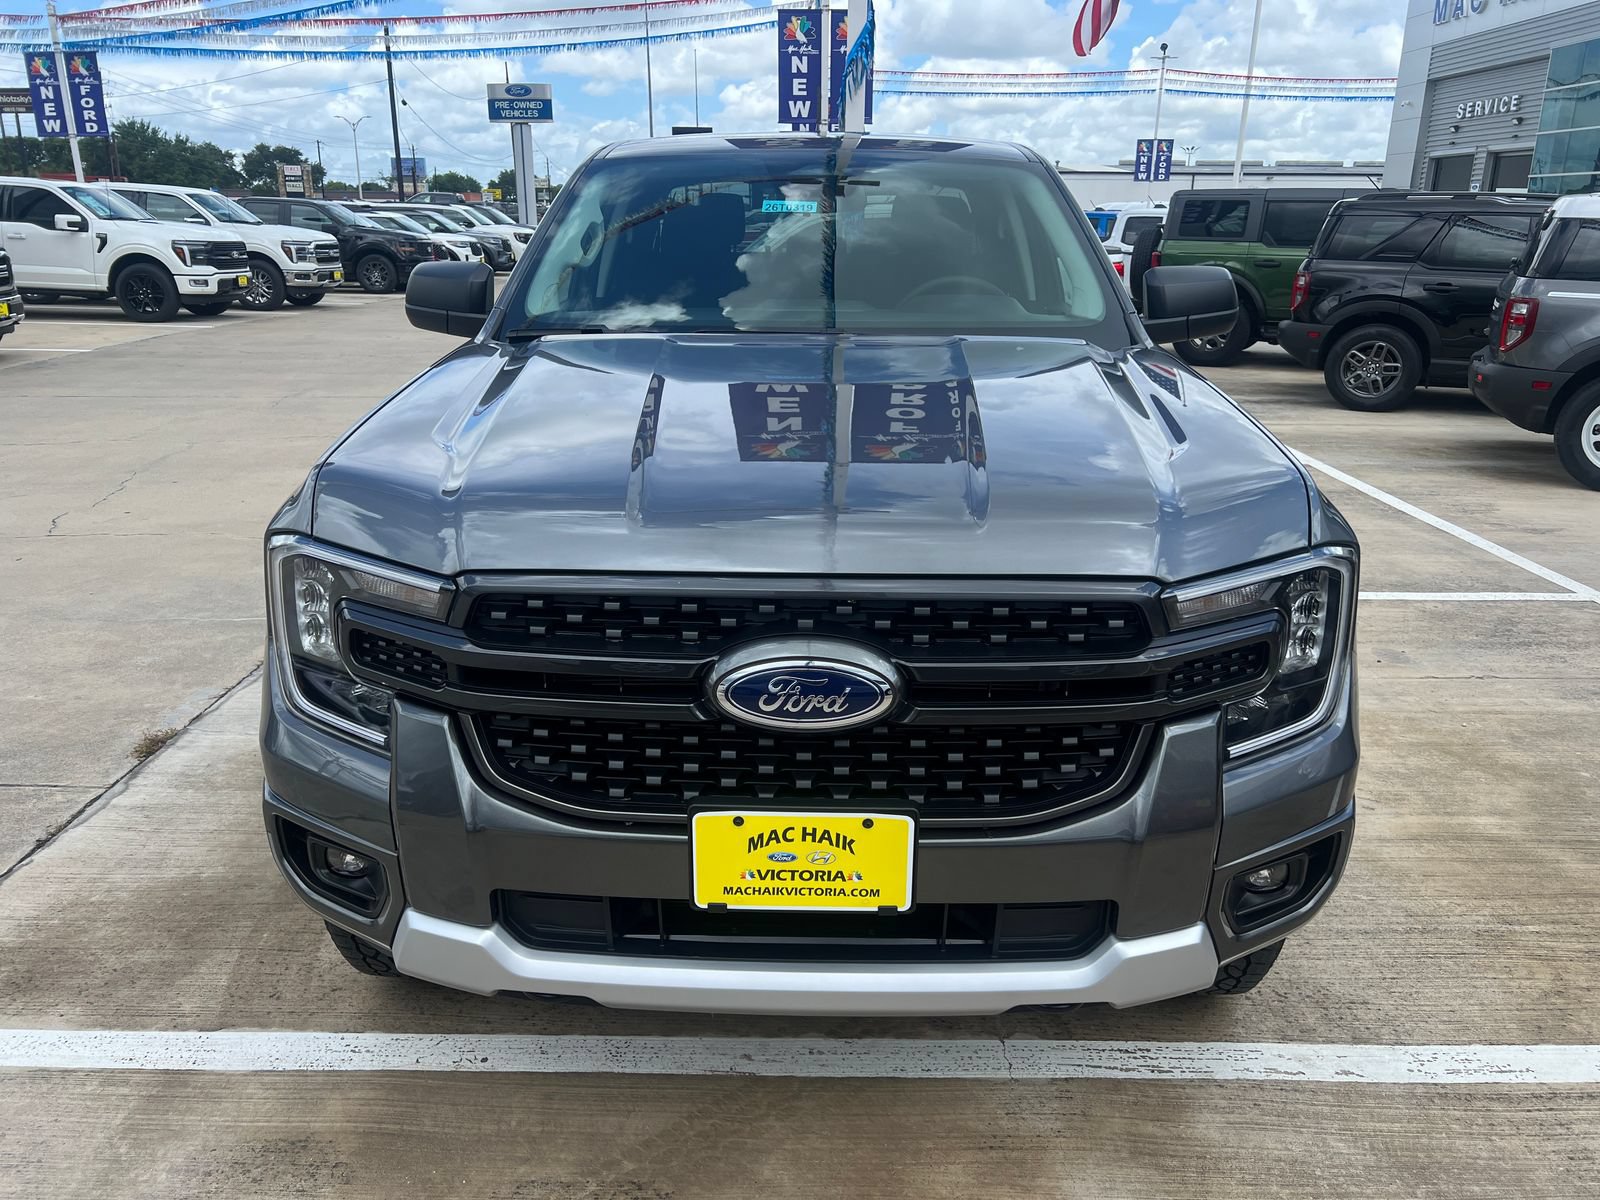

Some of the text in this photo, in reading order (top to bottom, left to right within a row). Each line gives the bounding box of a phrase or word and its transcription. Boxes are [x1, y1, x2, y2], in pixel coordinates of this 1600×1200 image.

[510, 87, 526, 95] Ford
[788, 55, 811, 117] NEW
[40, 86, 61, 132] NEW
[79, 85, 98, 132] FORD
[494, 101, 544, 109] PRE-OWNED
[500, 109, 539, 118] VEHICLES
[1456, 94, 1520, 119] SERVICE
[1137, 156, 1148, 180] NEW
[1158, 155, 1167, 180] FORD
[764, 203, 813, 211] 26T0319
[758, 675, 852, 713] Ford
[747, 826, 856, 856] MAC HAIK
[772, 853, 793, 861] Ford
[756, 869, 847, 882] VICTORIA
[722, 886, 881, 898] MACHAIKVICTORIA.COM
